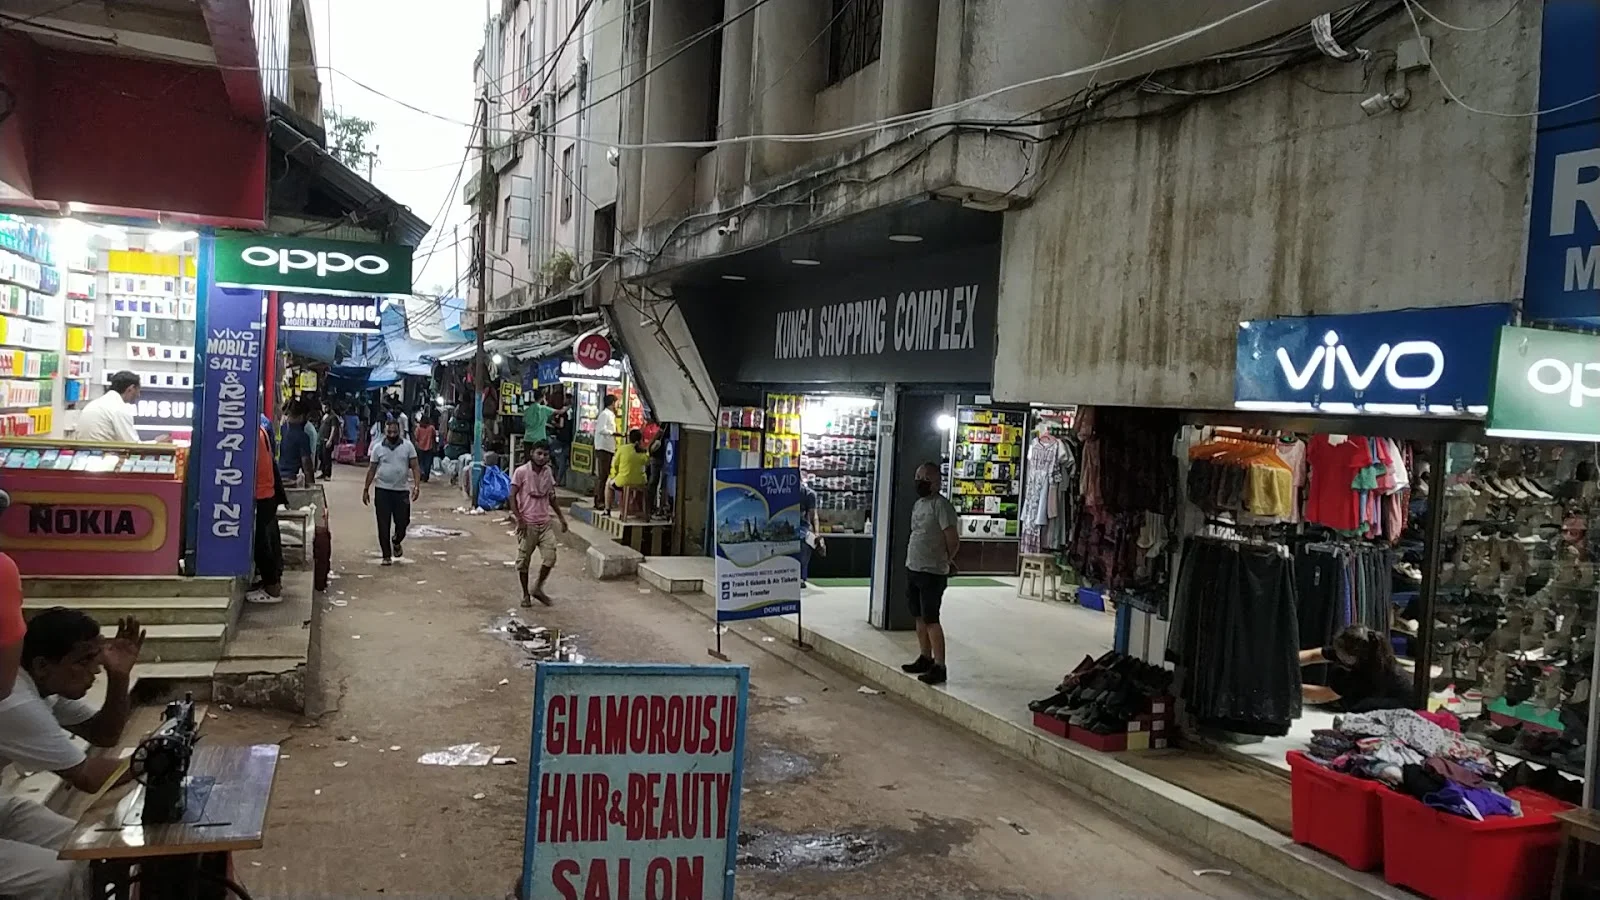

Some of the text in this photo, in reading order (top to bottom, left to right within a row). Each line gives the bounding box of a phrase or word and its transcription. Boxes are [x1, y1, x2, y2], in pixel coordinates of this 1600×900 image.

[283, 302, 376, 322] SAMSUNG
[774, 284, 979, 360] KUNGA SHOPPING COMPLEX
[316, 318, 360, 329] REPAIRING
[207, 338, 259, 357] MOBILE
[579, 342, 607, 362] Jio
[210, 356, 252, 371] SALE
[1276, 330, 1444, 390] vivo
[224, 371, 240, 384] &
[212, 382, 246, 538] REPAIRING
[760, 473, 797, 491] DAVID
[28, 506, 136, 535] NOKIA
[764, 604, 797, 614] DONE HERE
[552, 856, 704, 900] SALON
